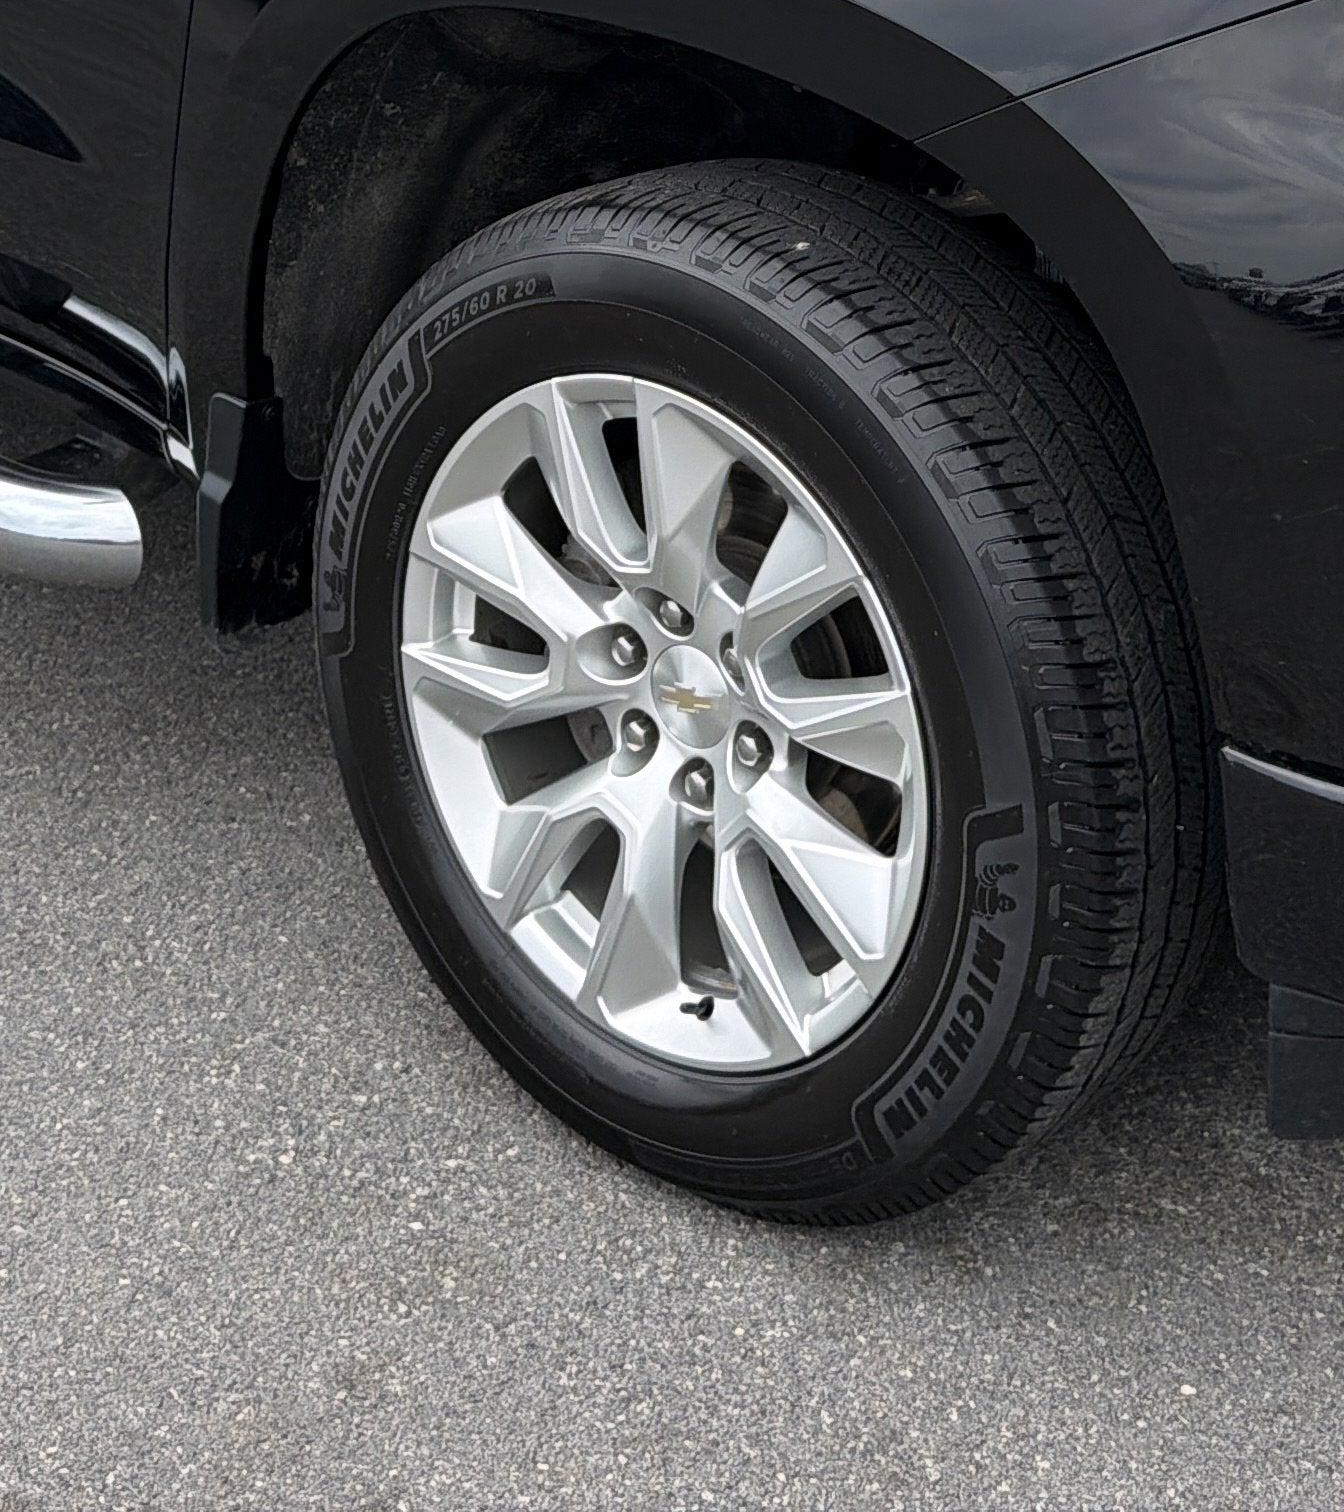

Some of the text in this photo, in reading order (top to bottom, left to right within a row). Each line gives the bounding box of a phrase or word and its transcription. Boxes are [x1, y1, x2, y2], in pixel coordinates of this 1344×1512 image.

[433, 277, 537, 342] 275/60 R 20
[327, 358, 410, 561] MICHELIN
[881, 925, 1006, 1140] MICHELIN
